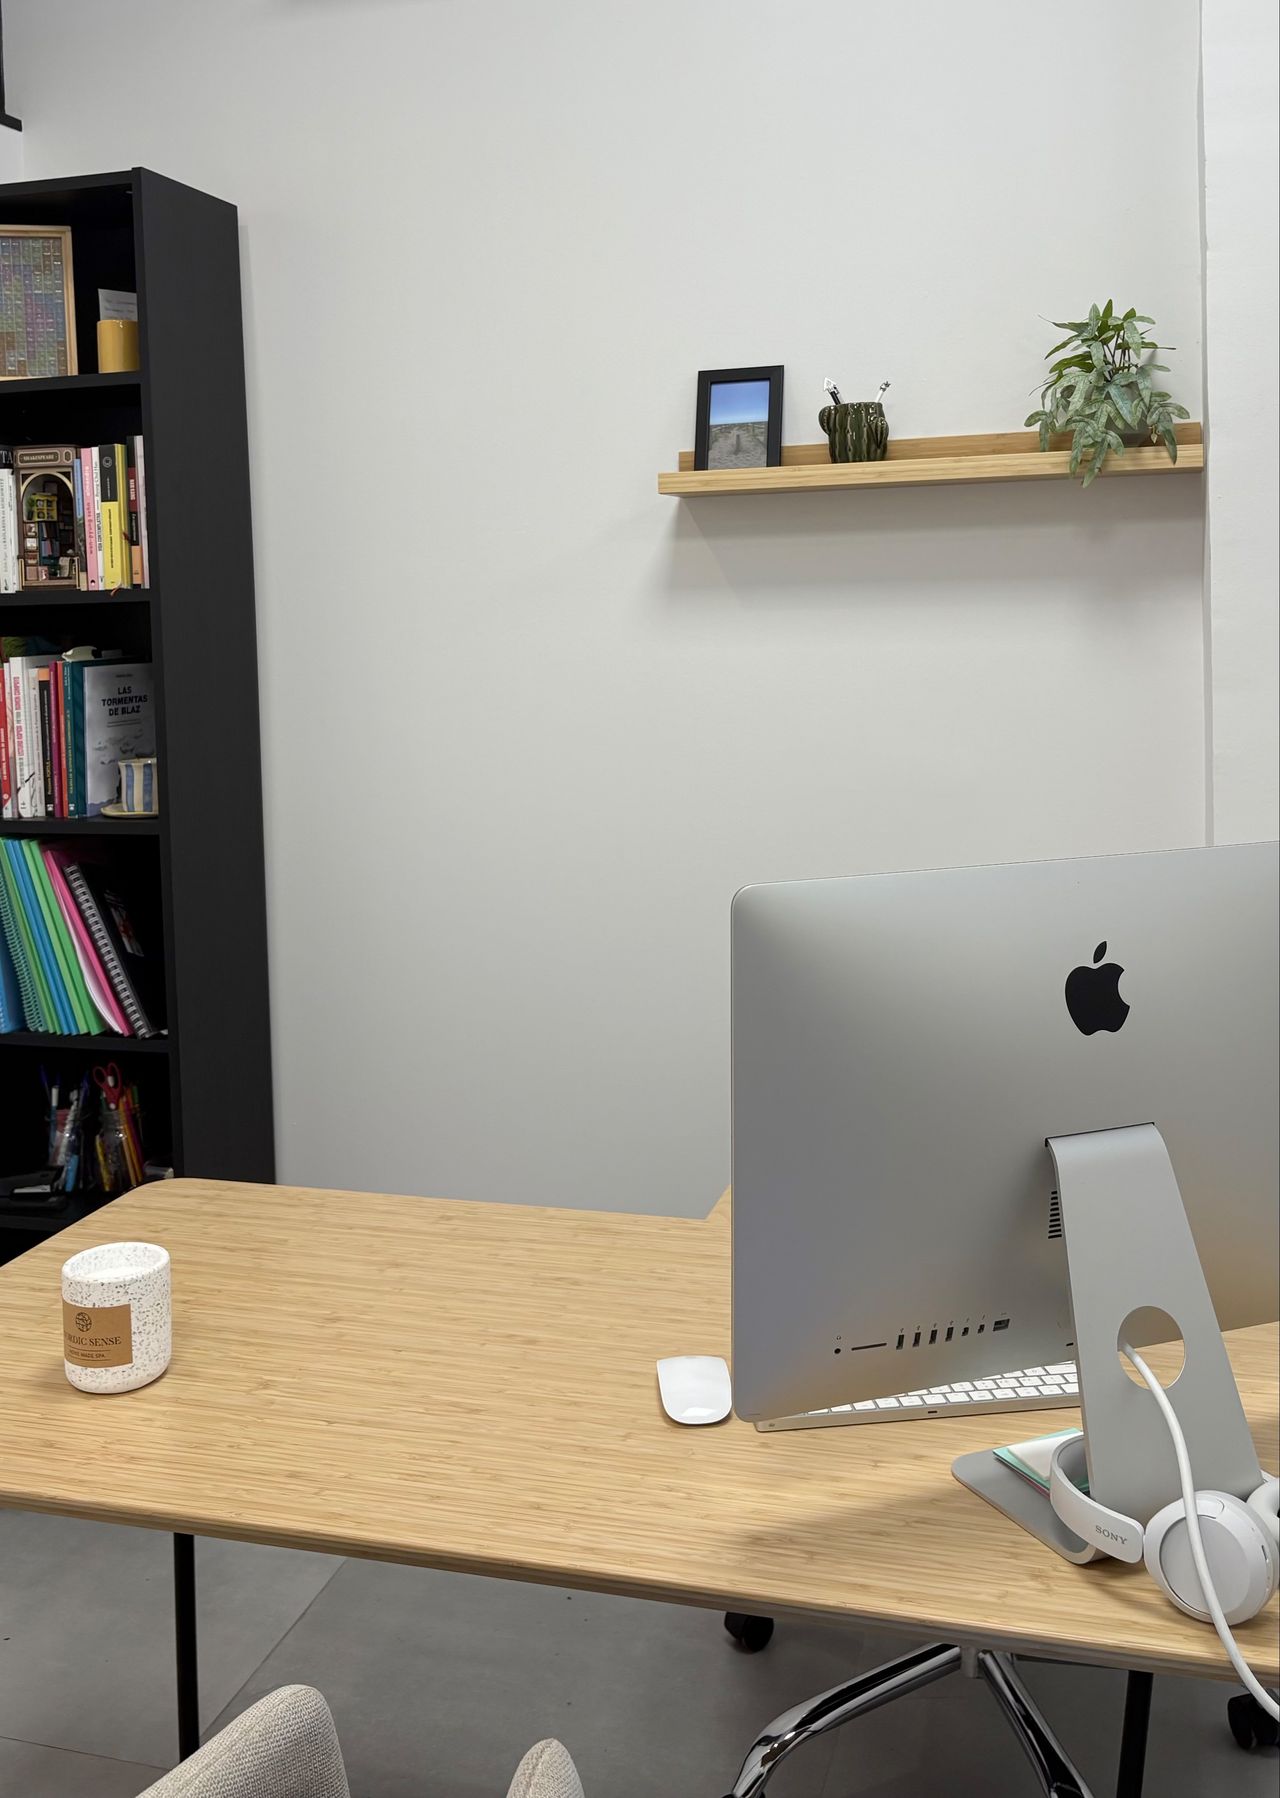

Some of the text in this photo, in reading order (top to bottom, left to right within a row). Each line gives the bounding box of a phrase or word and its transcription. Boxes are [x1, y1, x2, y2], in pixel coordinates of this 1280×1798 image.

[117, 686, 132, 695] LAS
[101, 694, 148, 707] TORMENTAS
[108, 705, 141, 716] DE BLAZ
[89, 1336, 122, 1346] SENSE
[1095, 1525, 1128, 1545] SONY
